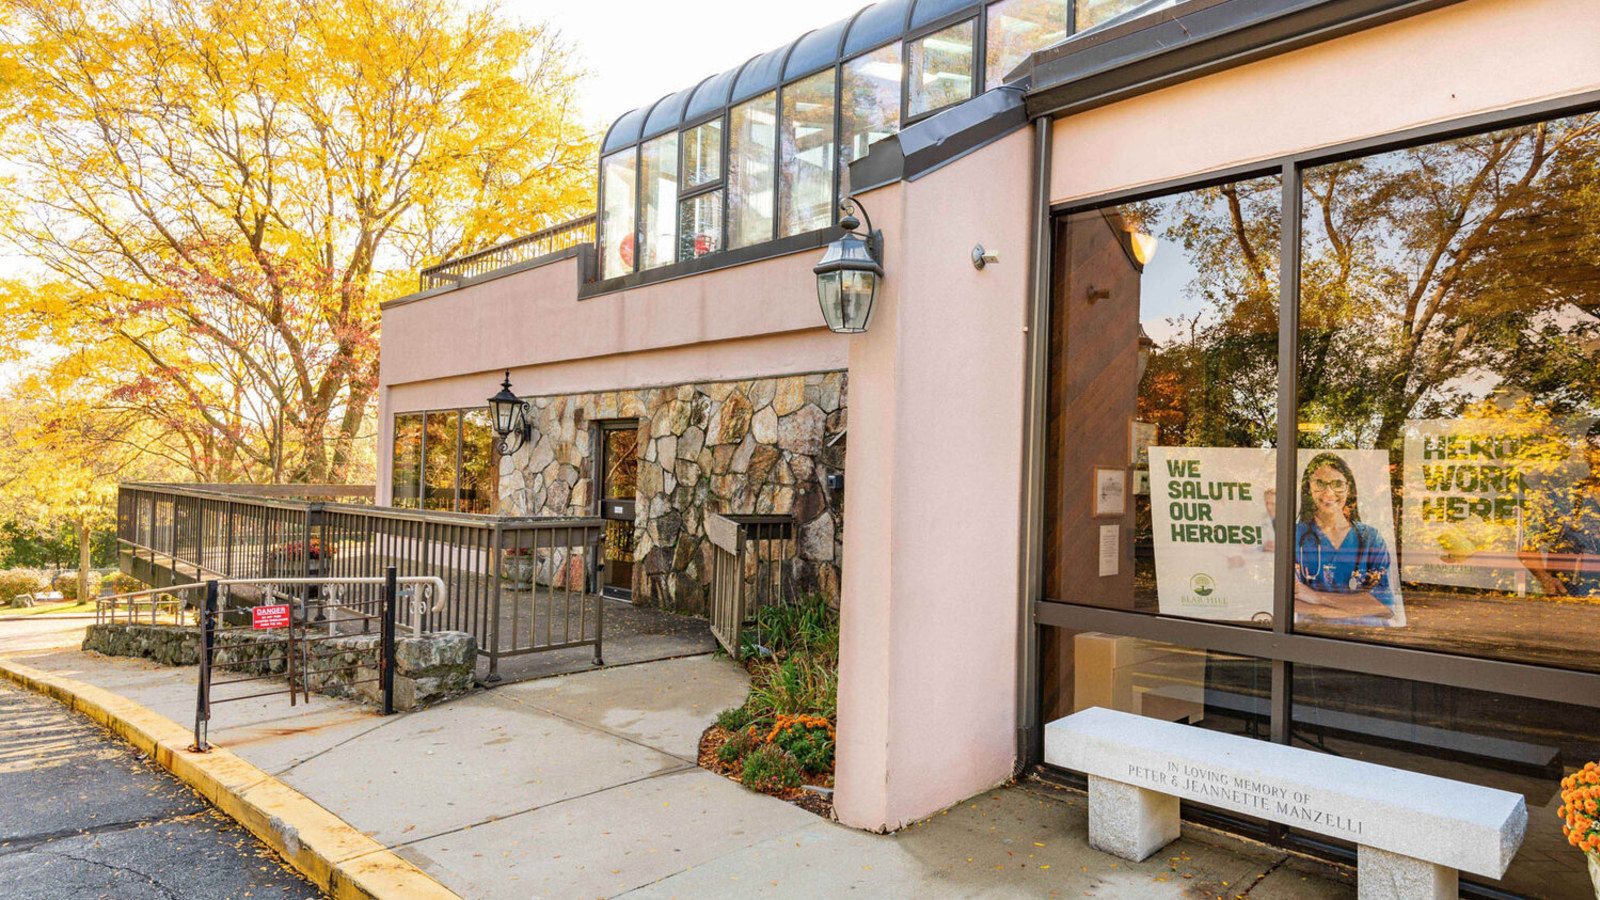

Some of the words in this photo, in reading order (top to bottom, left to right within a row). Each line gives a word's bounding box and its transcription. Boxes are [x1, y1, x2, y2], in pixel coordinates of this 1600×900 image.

[1166, 459, 1201, 478] WE
[1422, 465, 1532, 493] WORK
[1168, 480, 1252, 501] SALUTE
[1169, 502, 1213, 521] OUR
[1171, 523, 1263, 545] HEROES!
[256, 607, 286, 615] DANGER
[1167, 761, 1179, 772] IN
[1184, 765, 1229, 785] LOVING
[1234, 777, 1287, 799] MEMORY
[1293, 791, 1311, 804] OF
[1128, 764, 1167, 784] PETER
[1171, 775, 1178, 787] &
[1182, 778, 1269, 811] JEANNETTE
[1276, 801, 1363, 834] MANZELLI
